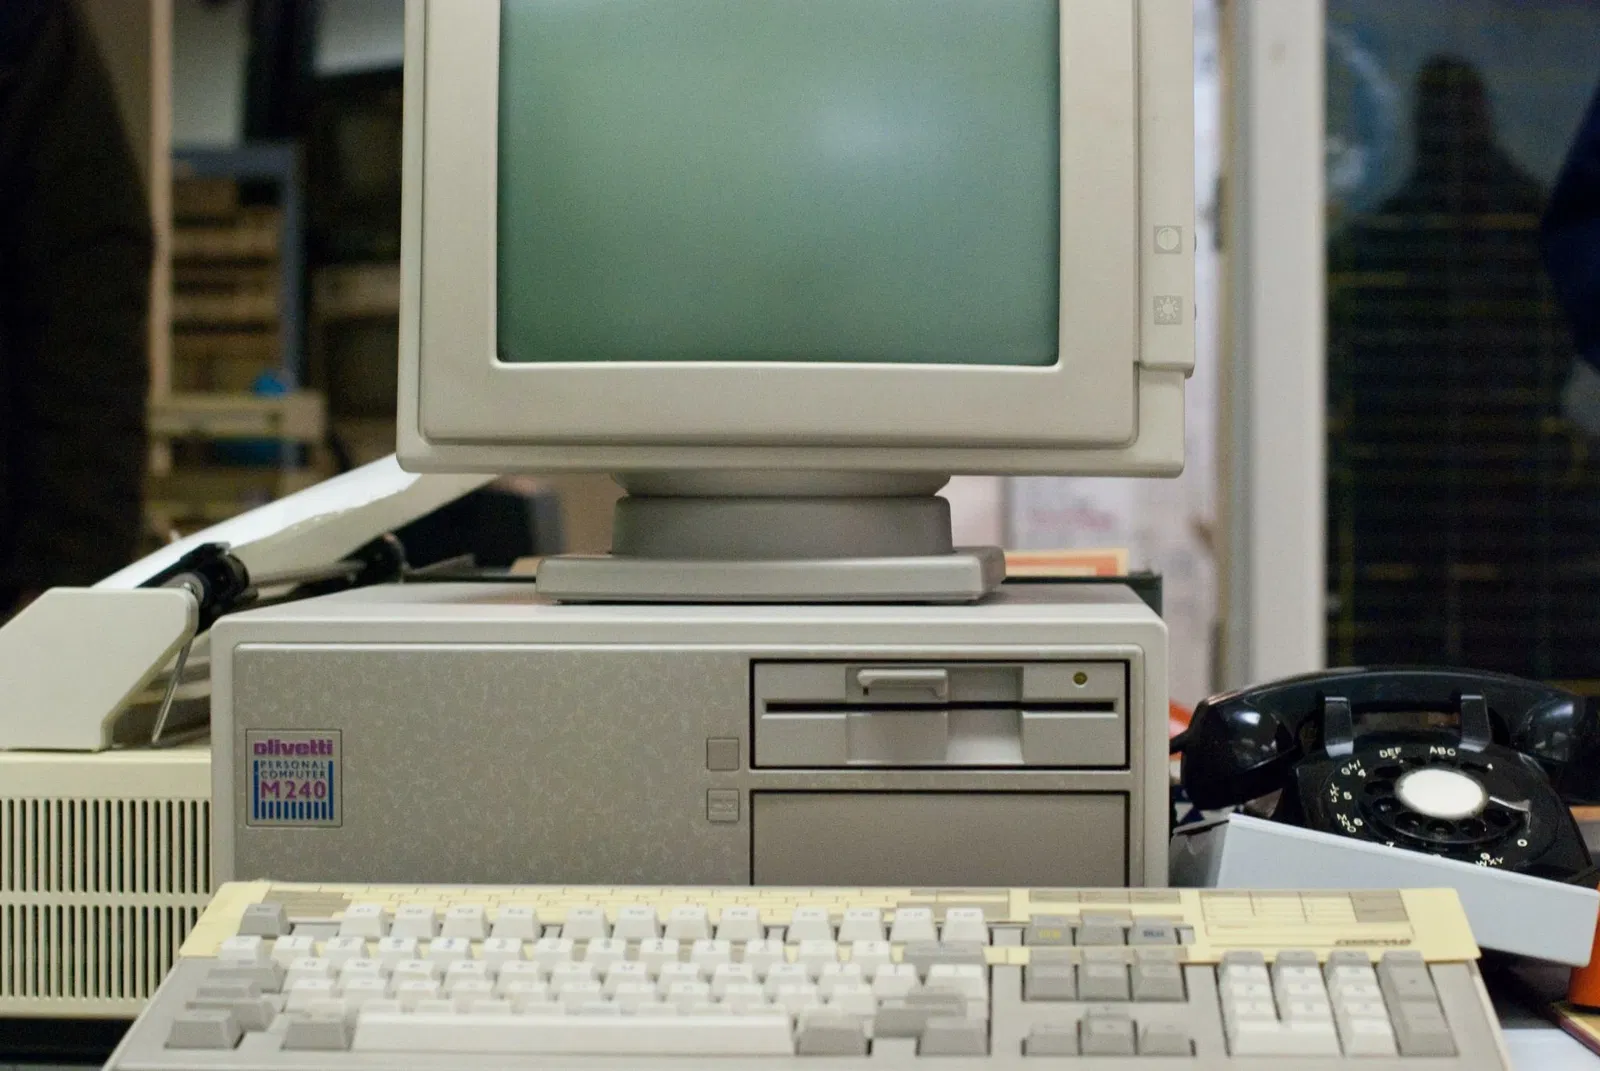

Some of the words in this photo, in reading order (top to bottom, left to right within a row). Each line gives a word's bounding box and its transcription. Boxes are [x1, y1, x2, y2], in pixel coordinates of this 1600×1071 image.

[253, 739, 333, 755] olivetti
[259, 760, 326, 769] PERSONAL
[259, 770, 326, 779] COMPUTER
